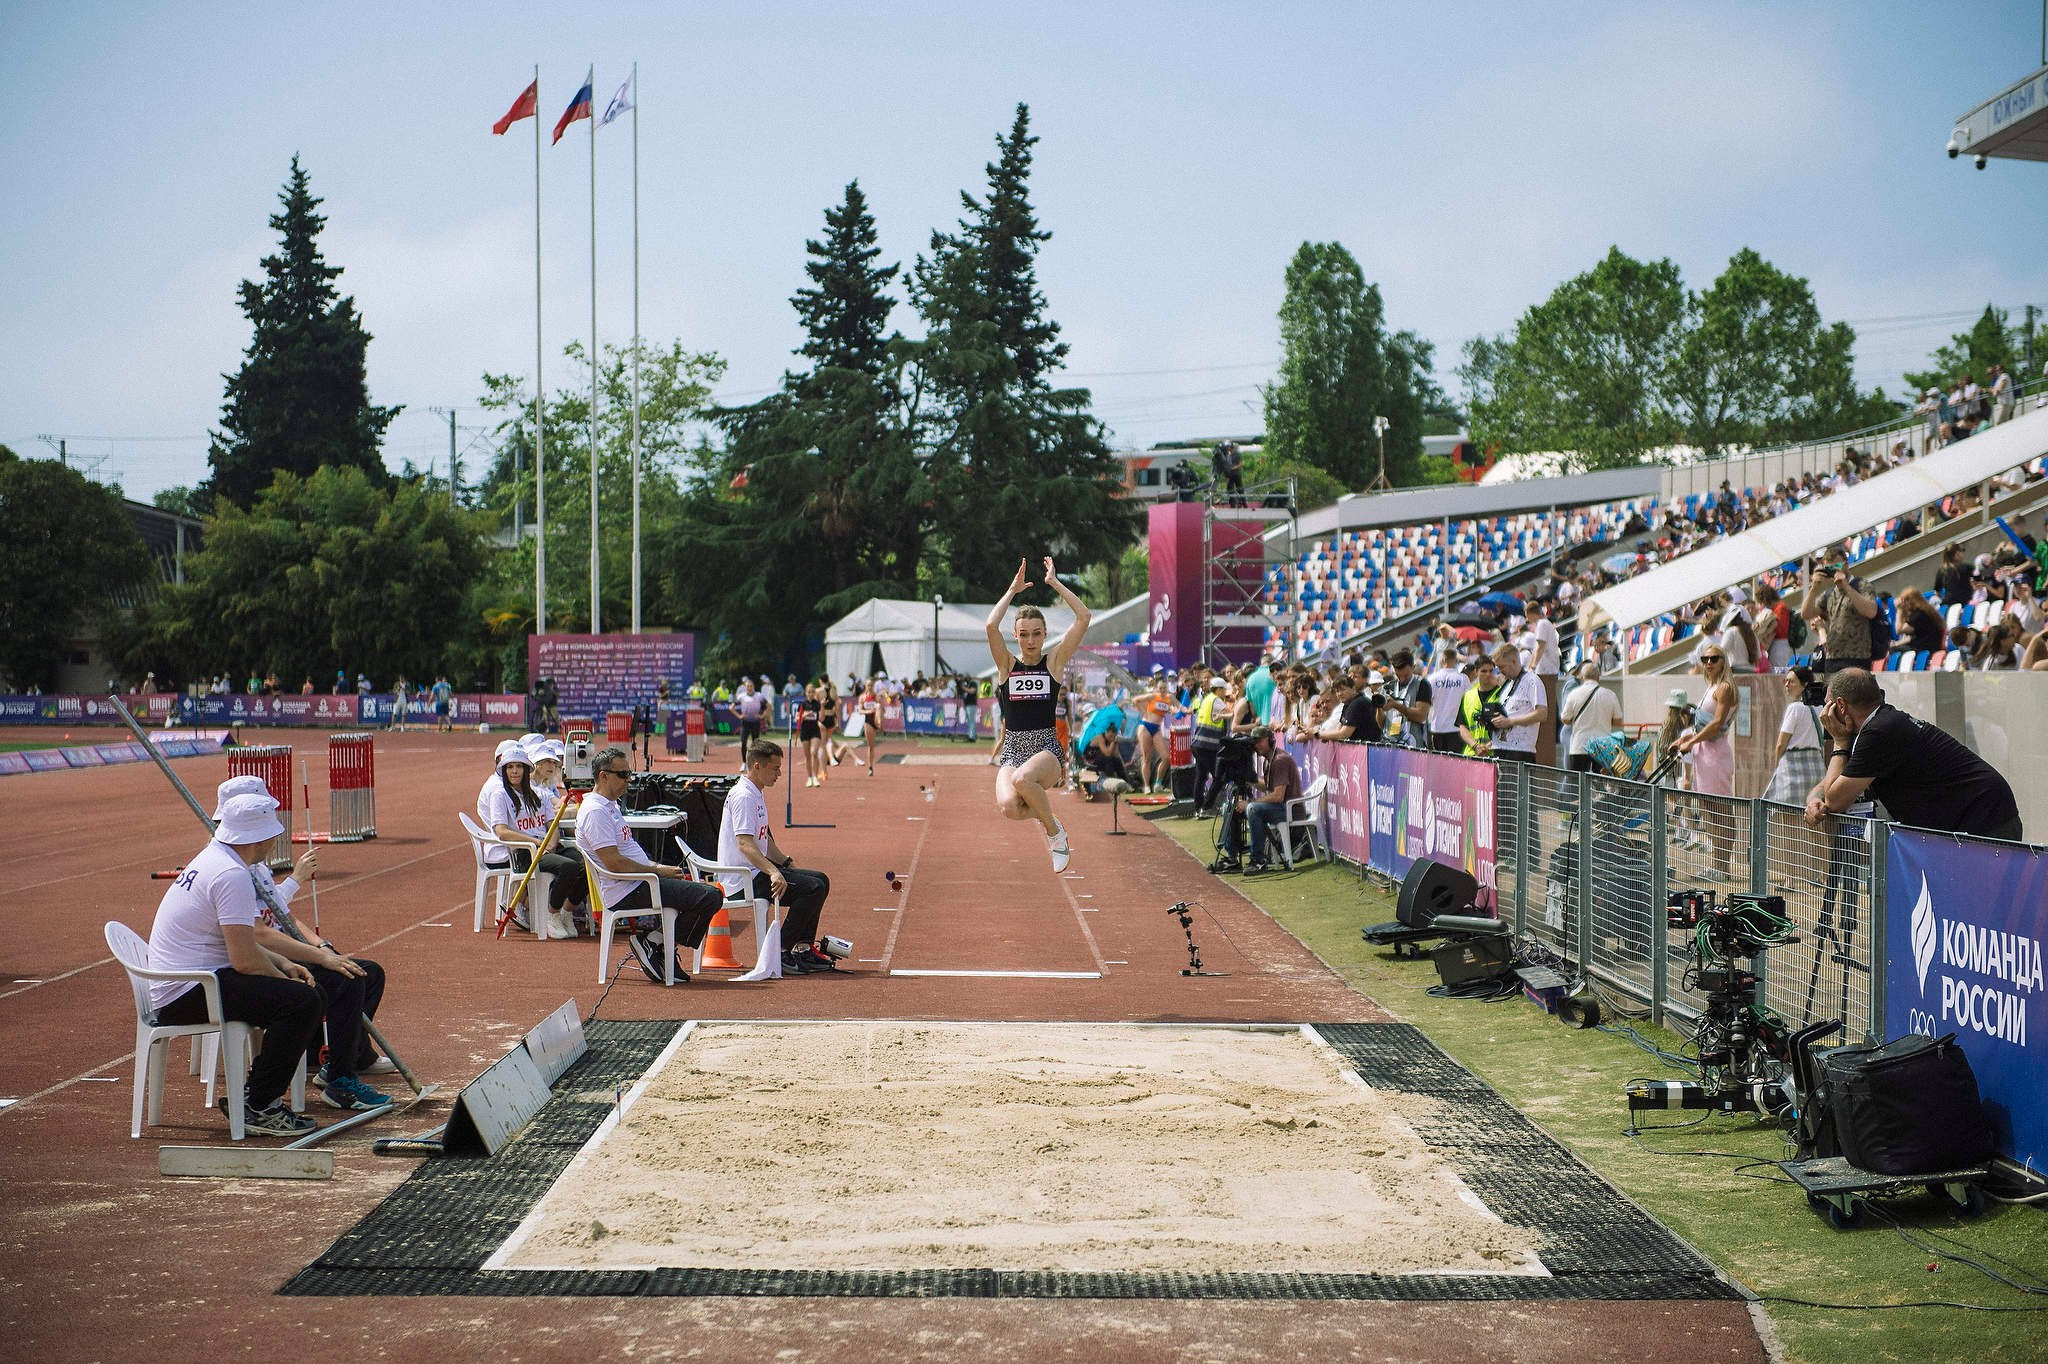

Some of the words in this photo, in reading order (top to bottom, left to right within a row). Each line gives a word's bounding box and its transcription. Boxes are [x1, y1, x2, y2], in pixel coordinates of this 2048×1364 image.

[1016, 679, 1044, 691] 299
[1435, 680, 1461, 689] СУДЬЯ
[59, 698, 81, 710] URAL
[1942, 919, 2044, 993] КОМАНДА
[1941, 975, 2026, 1047] РОССИИ
